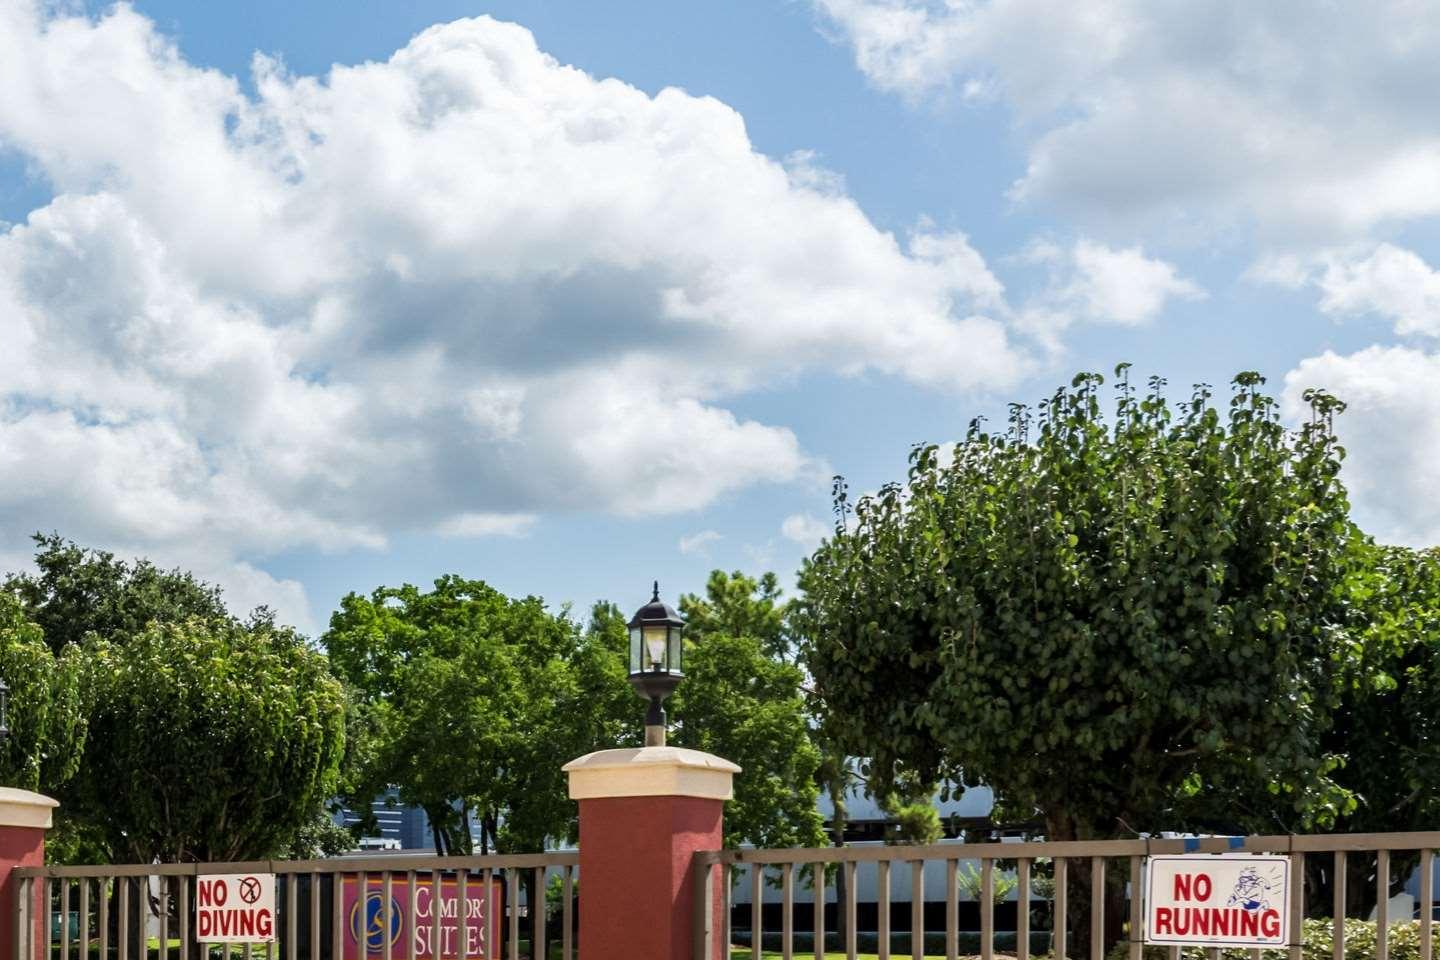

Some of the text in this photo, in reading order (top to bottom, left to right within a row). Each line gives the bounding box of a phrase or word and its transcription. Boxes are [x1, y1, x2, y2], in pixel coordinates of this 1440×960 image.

[199, 879, 228, 907] NO
[1174, 874, 1213, 902] NO
[415, 887, 486, 919] CMOR
[198, 908, 272, 937] DIVING
[1155, 907, 1280, 938] RUNNING
